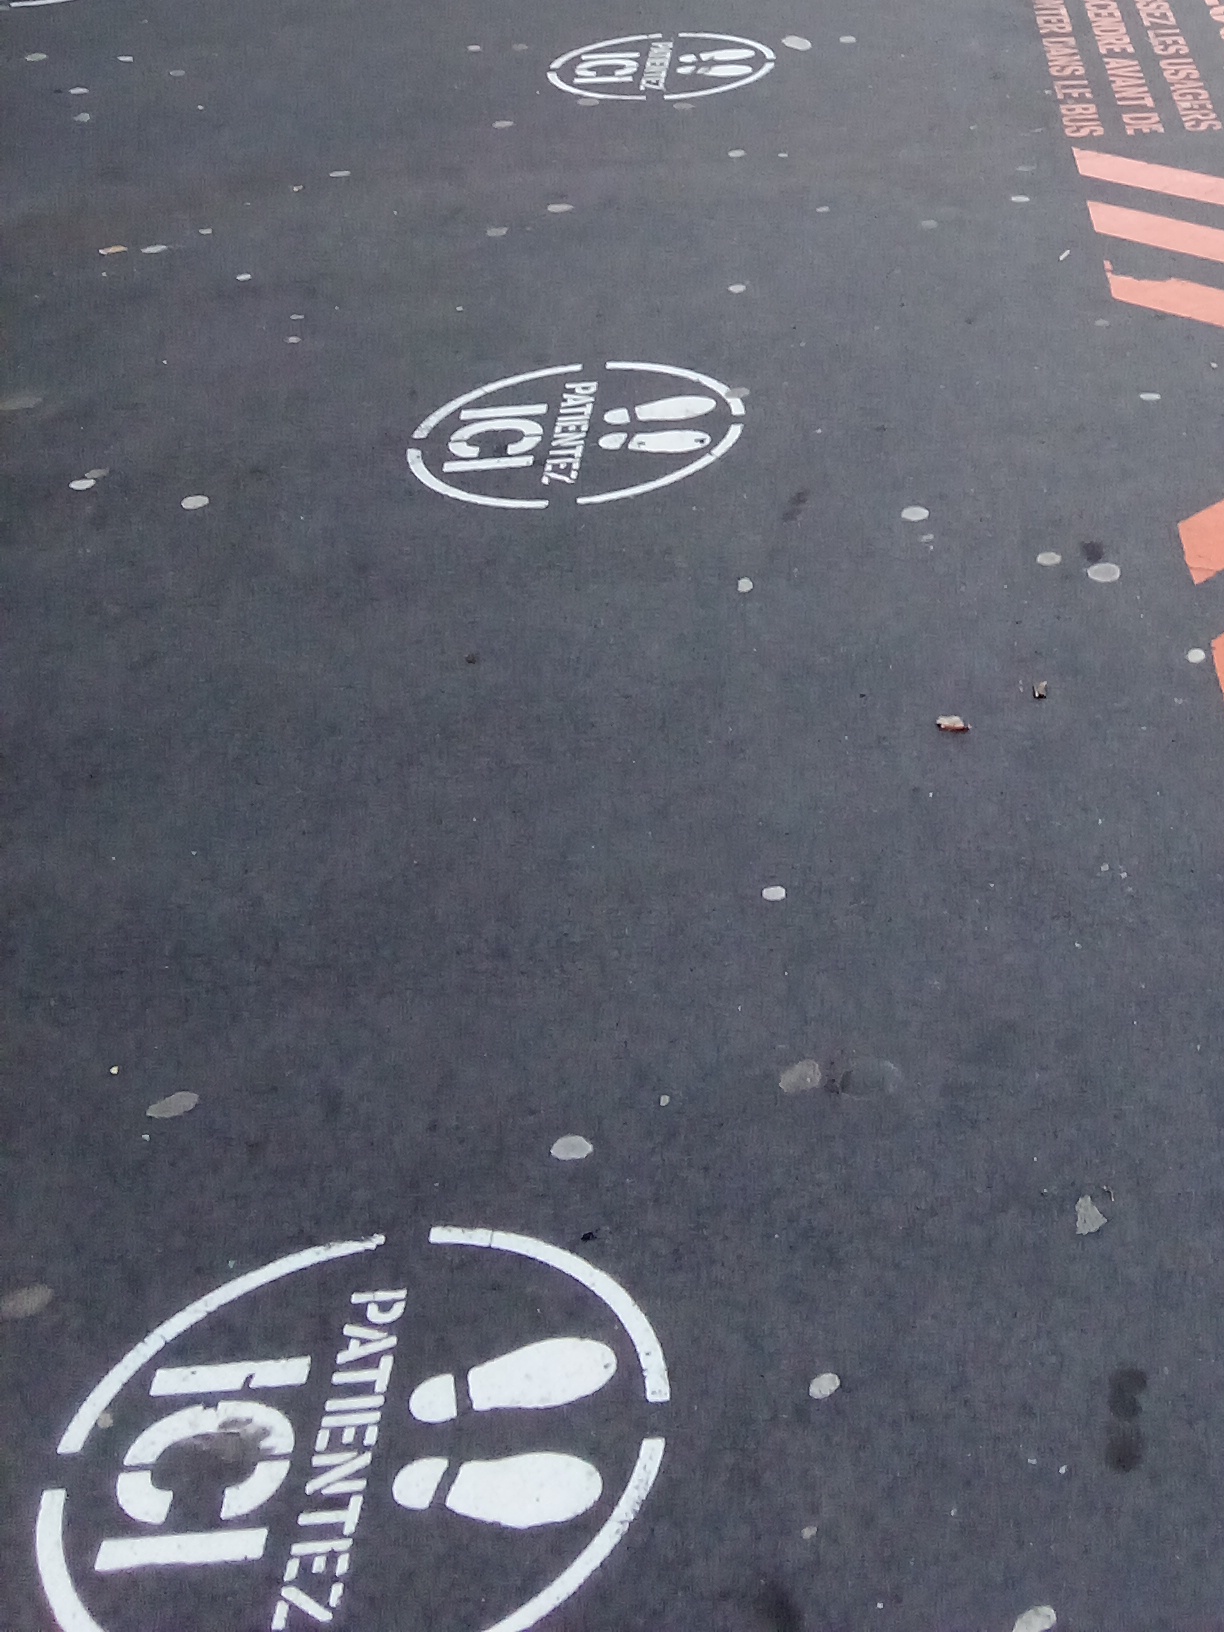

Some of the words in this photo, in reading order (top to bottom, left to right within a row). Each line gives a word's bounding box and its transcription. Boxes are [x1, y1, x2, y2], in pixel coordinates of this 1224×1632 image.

[1147, 28, 1190, 56] LES
[573, 52, 640, 84] ICI
[1053, 80, 1093, 100] LE
[1103, 58, 1155, 108] AVANT
[1159, 58, 1223, 132] USAGERS
[1060, 103, 1105, 138] BUS
[1121, 112, 1165, 136] DE
[443, 403, 548, 472] ICI
[541, 381, 598, 485] PATIENTEZ
[95, 1356, 311, 1572] ICI
[271, 1287, 407, 1632] PATIENTEZ
